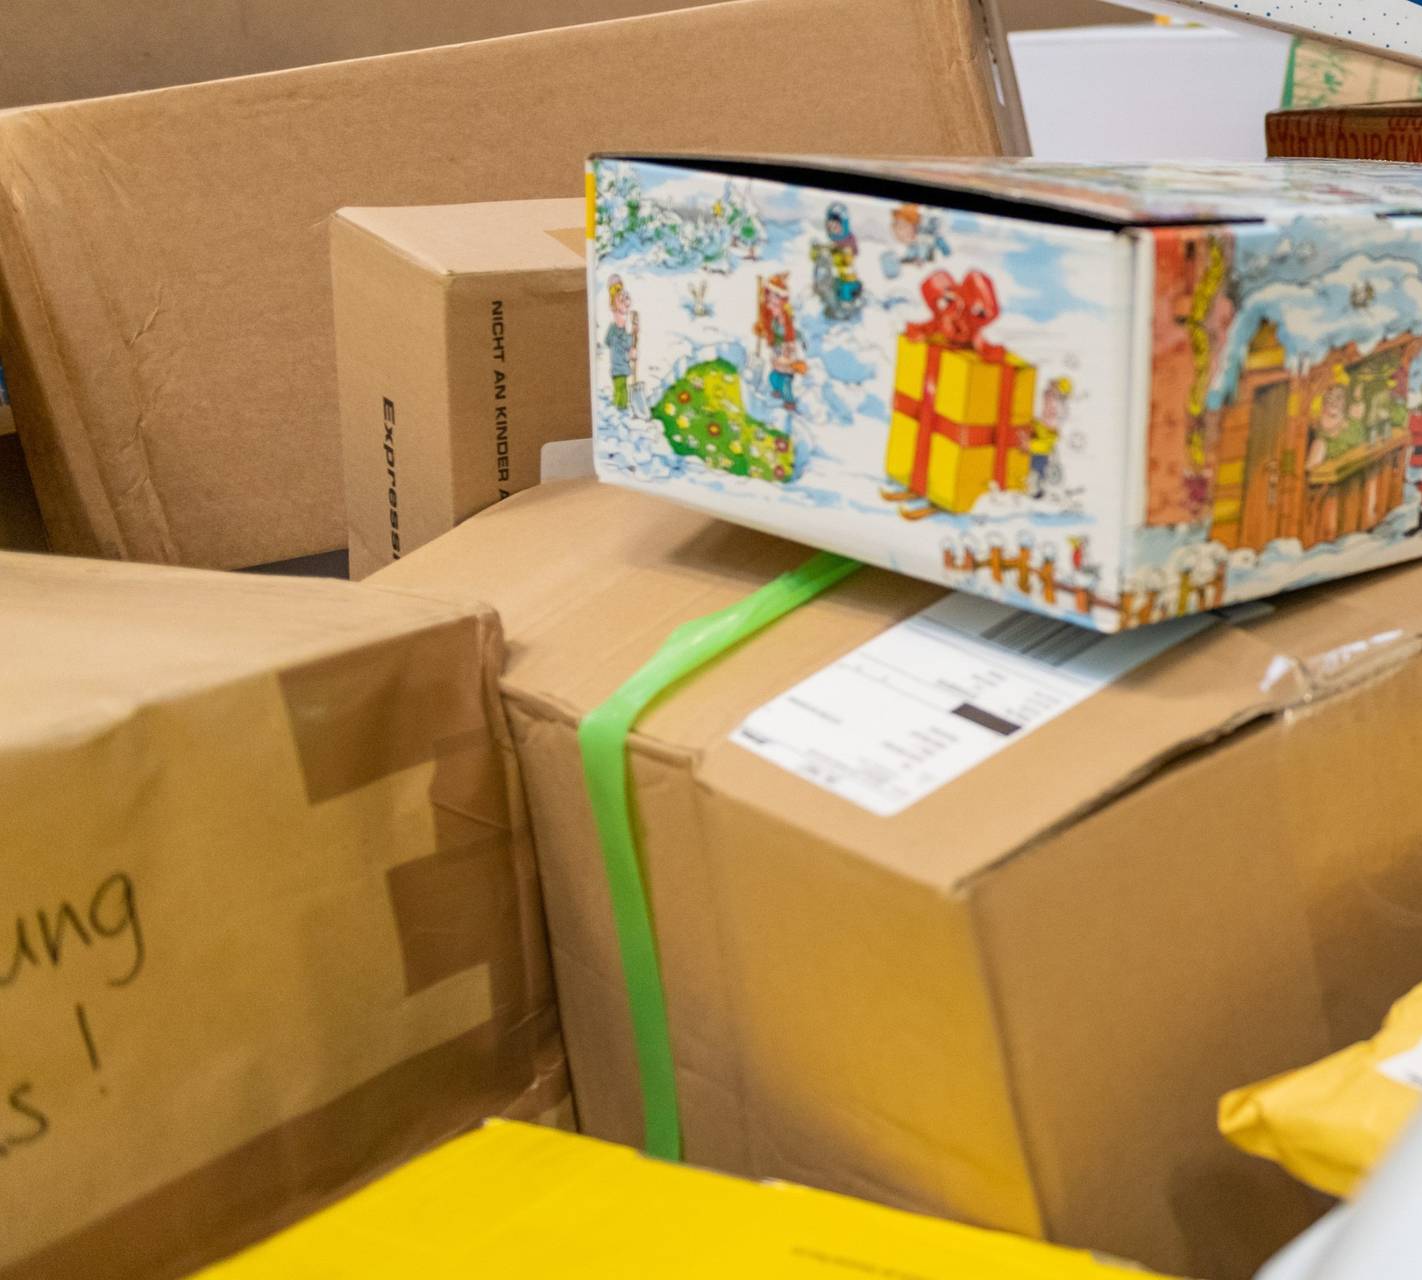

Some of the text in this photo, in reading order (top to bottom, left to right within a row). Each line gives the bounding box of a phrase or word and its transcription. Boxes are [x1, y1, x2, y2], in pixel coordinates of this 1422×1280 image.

[492, 301, 505, 362] NICHT
[494, 370, 506, 400] AN
[495, 406, 509, 482] KINDER
